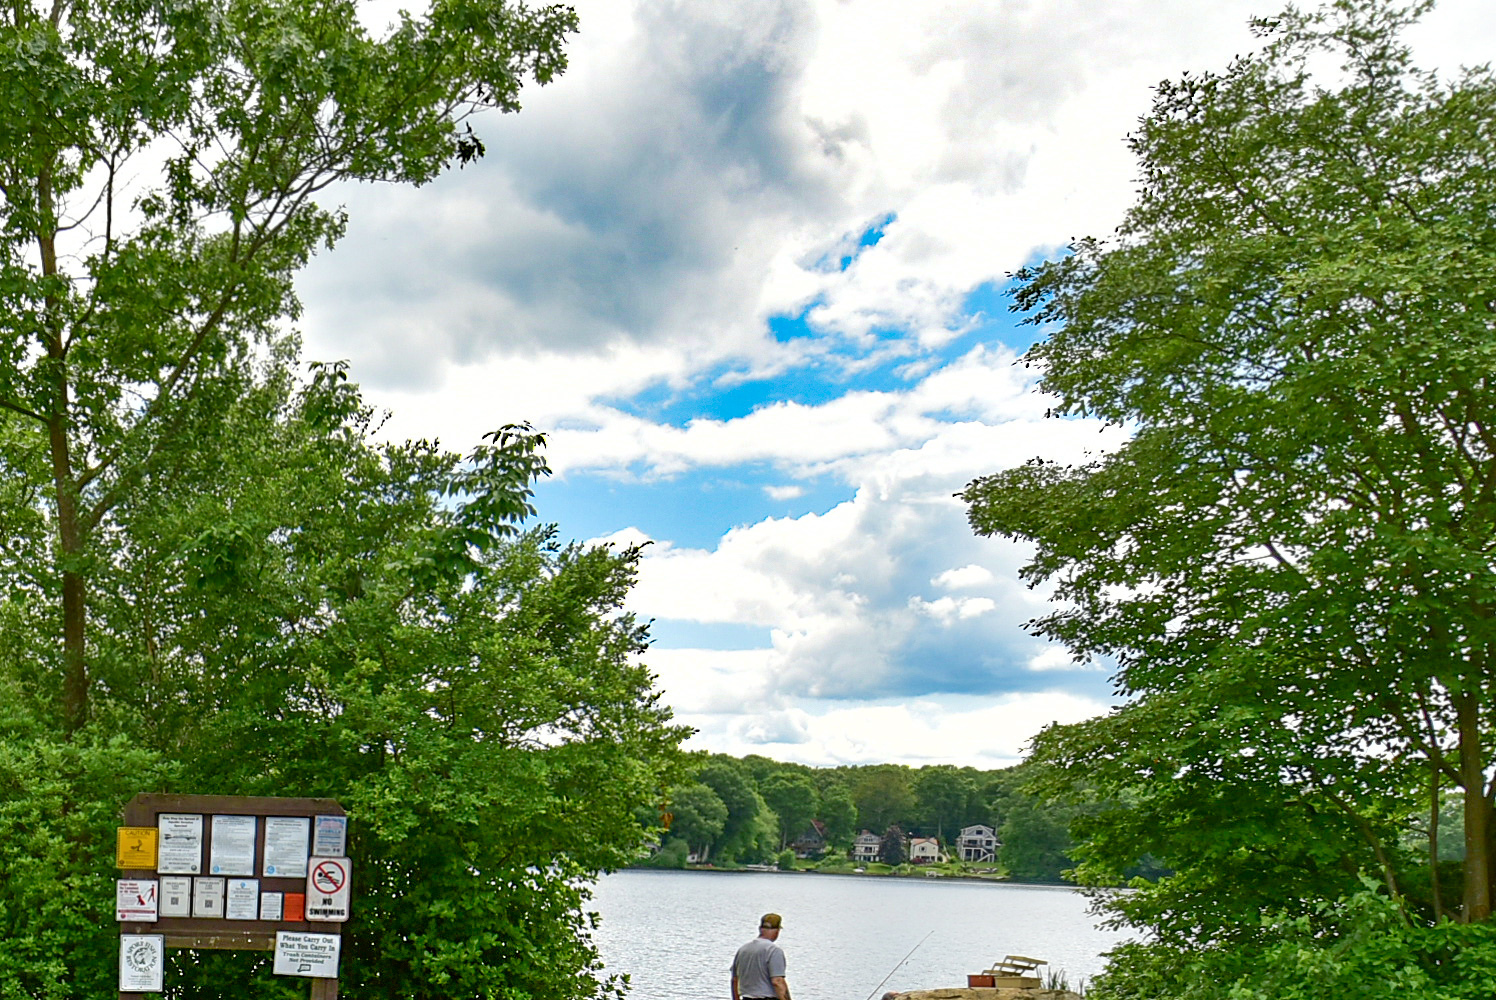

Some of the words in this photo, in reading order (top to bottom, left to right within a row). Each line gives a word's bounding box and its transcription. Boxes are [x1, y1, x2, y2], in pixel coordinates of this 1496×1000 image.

[303, 936, 321, 944] Carry
[126, 941, 144, 953] SPORT
[144, 942, 157, 954] FISH
[310, 944, 327, 952] Carry
[126, 955, 157, 973] RESTORATION
